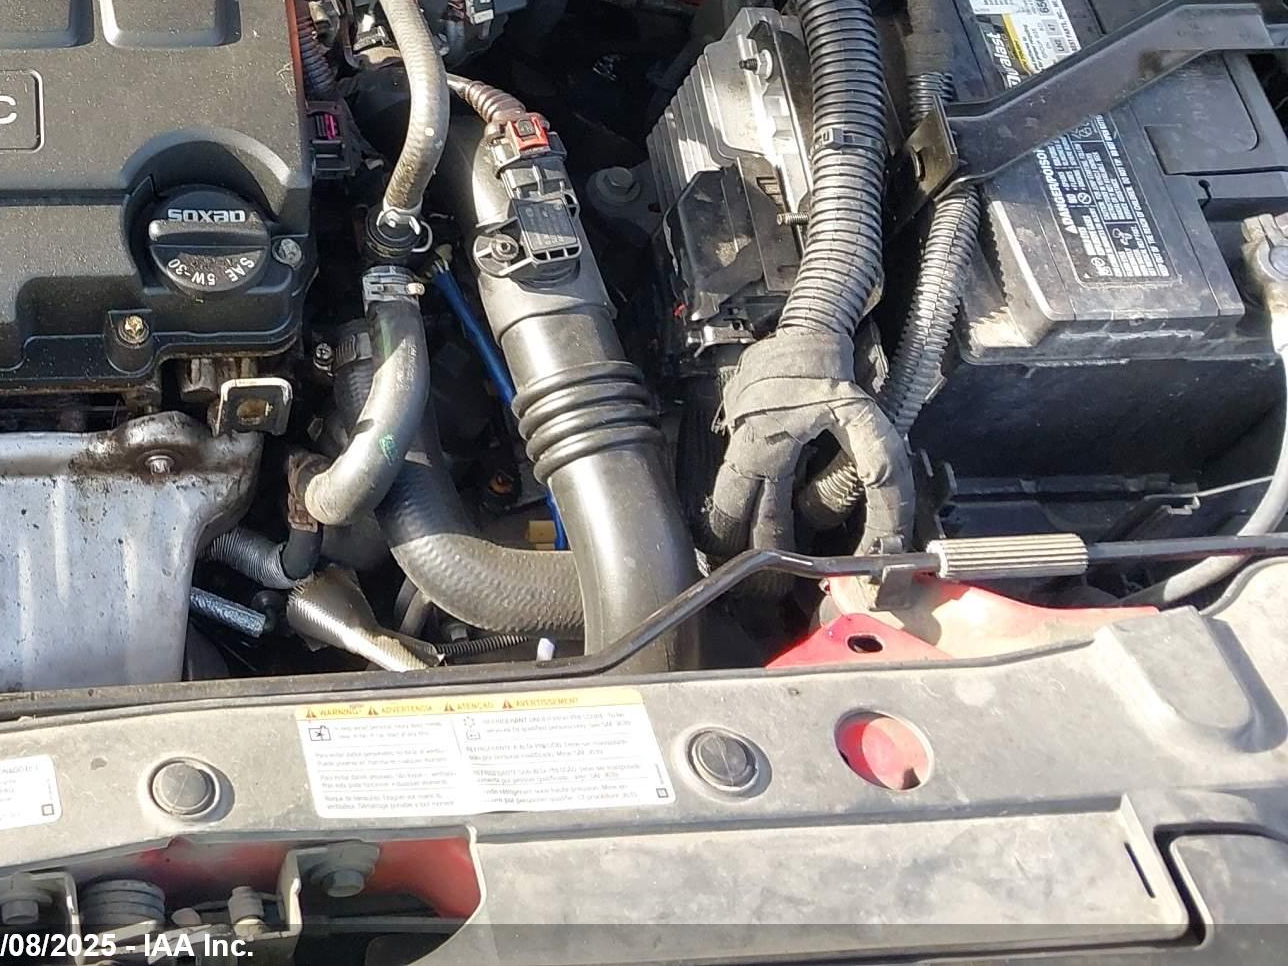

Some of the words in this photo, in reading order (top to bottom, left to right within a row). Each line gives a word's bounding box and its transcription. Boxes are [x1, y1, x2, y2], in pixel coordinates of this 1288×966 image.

[168, 259, 216, 285] 5W-30
[225, 257, 255, 282] SAE
[381, 705, 432, 714] ADVERTENCIA
